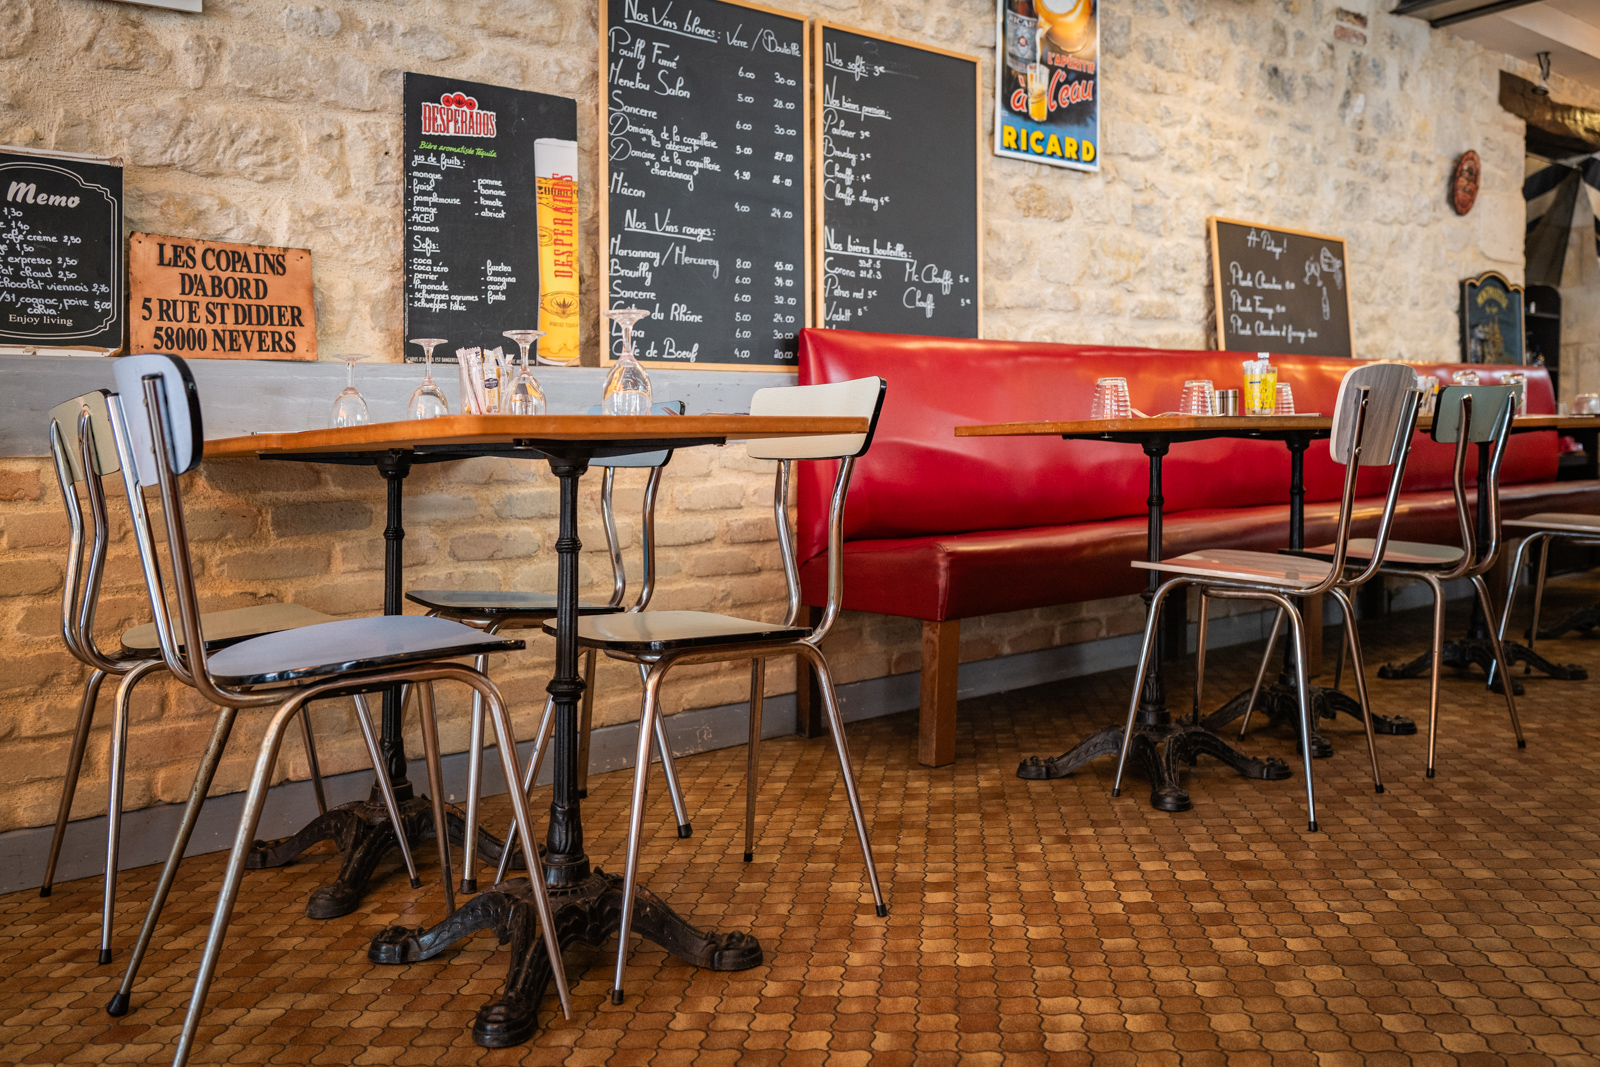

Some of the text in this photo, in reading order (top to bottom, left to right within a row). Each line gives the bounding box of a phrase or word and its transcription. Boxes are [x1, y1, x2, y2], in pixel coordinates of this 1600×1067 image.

[624, 0, 648, 22] Nos
[652, 1, 677, 29] Vins
[727, 24, 748, 48] Verre
[609, 26, 646, 70] Pouilly
[652, 42, 679, 69] Fumé
[825, 42, 843, 66] Nos
[609, 59, 650, 91] Menetou
[654, 69, 690, 98] Salon
[824, 75, 840, 107] Nos
[1048, 69, 1094, 111] l'eau
[608, 90, 657, 119] Sancerre
[421, 103, 497, 138] DESPERADOS
[608, 112, 653, 136] Domaine
[661, 126, 670, 140] de
[673, 125, 680, 142] la
[419, 141, 437, 150] Bière
[439, 145, 475, 155] aromatisée
[609, 137, 656, 161] Domaine
[661, 151, 670, 162] de
[673, 152, 682, 165] la
[1002, 124, 1096, 162] RICARD
[412, 150, 425, 167] jus
[427, 153, 437, 163] de
[478, 178, 502, 190] pomme
[480, 185, 506, 196] banane
[610, 172, 645, 197] Mâcon
[6, 181, 80, 208] Memo
[480, 196, 503, 207] tomate
[411, 213, 430, 223] ACE
[413, 206, 438, 221] orange
[481, 208, 506, 218] abricot
[625, 208, 647, 229] Nos
[655, 208, 678, 232] Vins
[552, 173, 573, 279] DESPERADOS
[2, 228, 82, 246] café crème 2,50
[824, 225, 843, 251] Nos
[848, 235, 870, 254] bières
[8, 257, 52, 268] expresso
[57, 257, 78, 268] 2,50
[157, 243, 286, 276] LES COPAINS
[609, 234, 660, 267] Marsannay
[675, 245, 719, 279] Mercurey
[20, 266, 53, 278] chaud
[58, 271, 77, 281] 2,50
[433, 262, 449, 272] zéro
[609, 258, 652, 286] Brouilly
[824, 257, 855, 277] Corona
[47, 283, 89, 292] viennois
[179, 273, 268, 300] D'ABORD
[413, 272, 438, 284] perrier
[414, 279, 449, 291] limonade
[486, 274, 516, 289] orangina
[414, 290, 479, 306] schweppes agrumes
[487, 291, 506, 304] fanta
[610, 280, 656, 300] Sancerre
[63, 298, 89, 310] poire
[141, 297, 304, 327] 5 RUE ST DIDIER
[413, 299, 447, 312] schweppes
[651, 303, 664, 320] du
[670, 303, 703, 322] Rhône
[9, 314, 73, 326] Enjoy living
[153, 327, 296, 353] 58000 NEVERS
[645, 341, 658, 357] de
